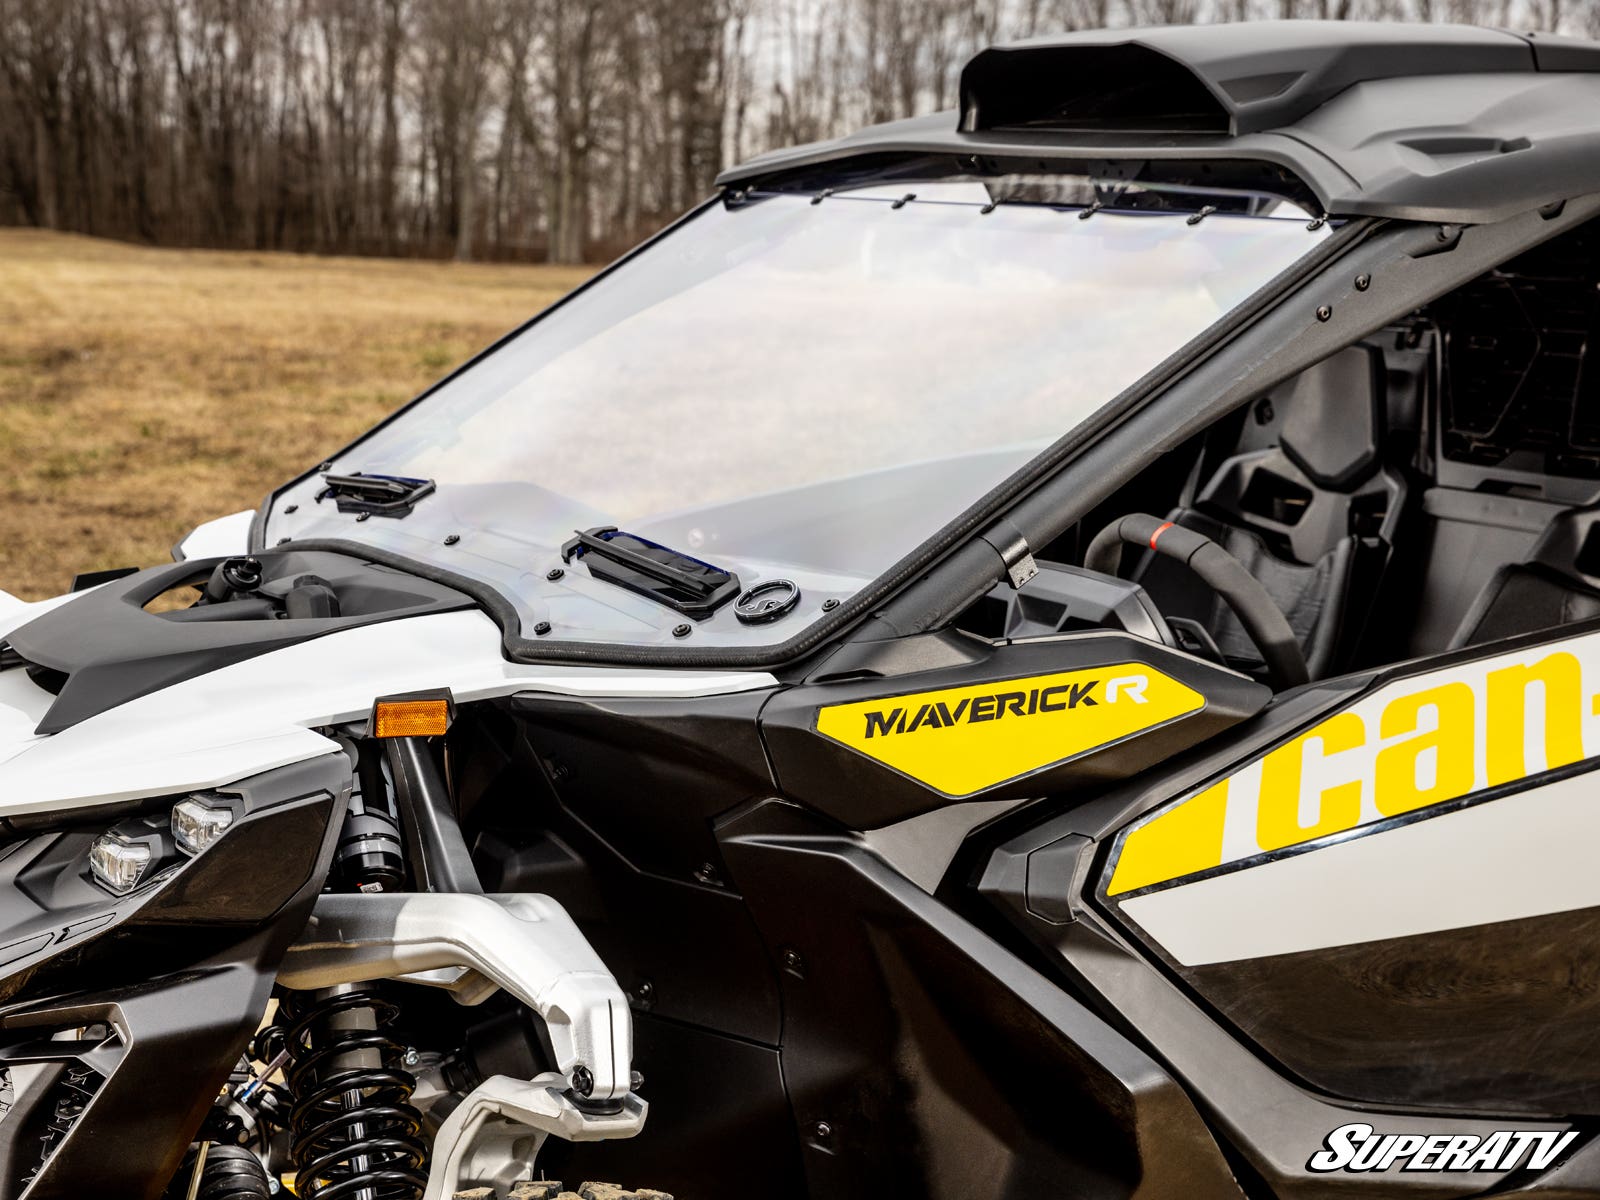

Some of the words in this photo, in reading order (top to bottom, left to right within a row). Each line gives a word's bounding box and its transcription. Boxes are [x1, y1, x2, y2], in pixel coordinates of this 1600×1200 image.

[864, 680, 1100, 739] MAVERICK
[1105, 674, 1149, 704] R
[1256, 651, 1600, 852] can
